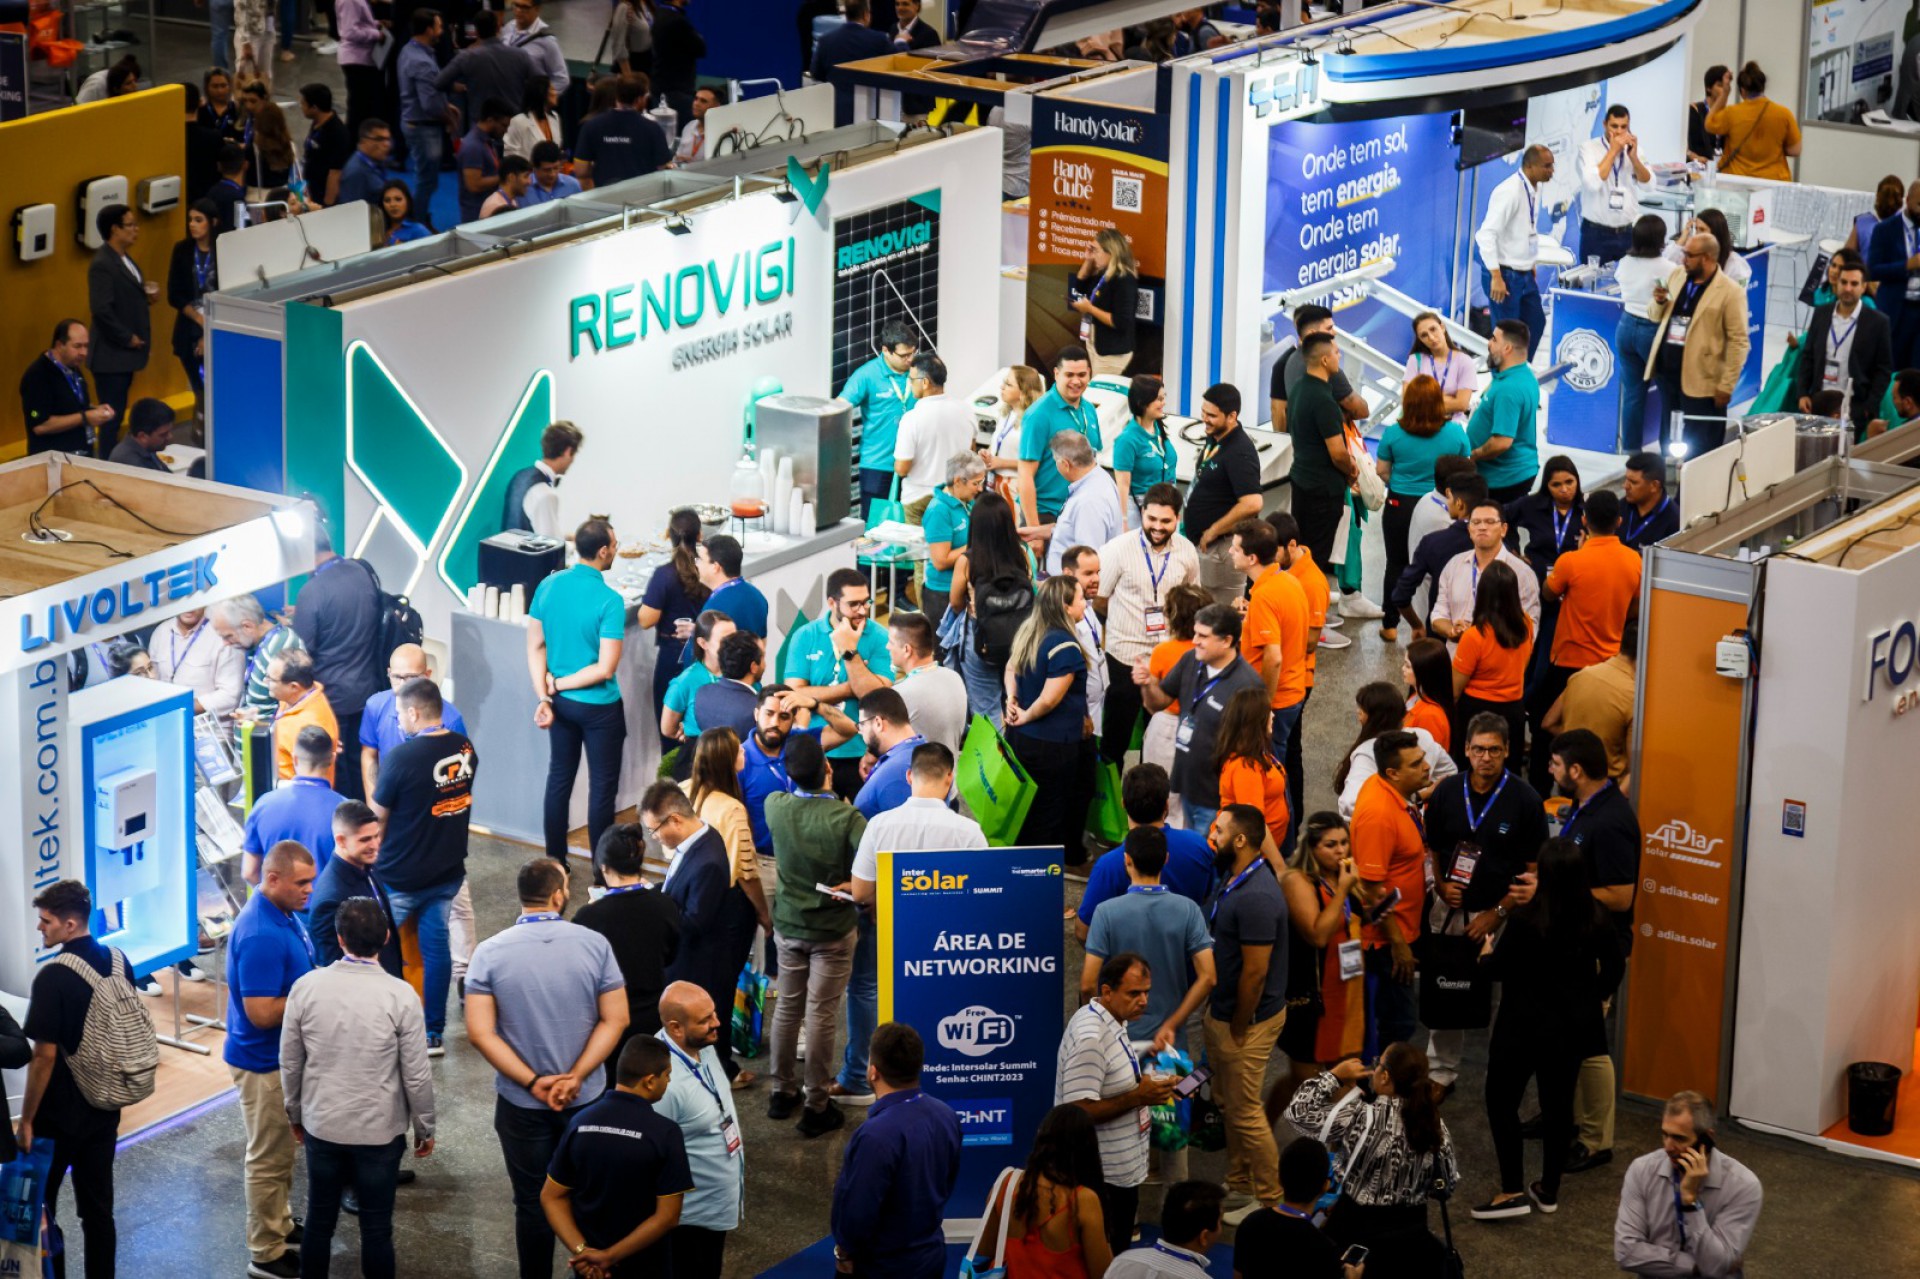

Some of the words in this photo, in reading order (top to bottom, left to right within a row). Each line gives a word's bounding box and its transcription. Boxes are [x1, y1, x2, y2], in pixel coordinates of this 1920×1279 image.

[1302, 144, 1347, 180] Onde
[1350, 138, 1381, 165] tem
[1384, 123, 1409, 155] sol,
[1053, 158, 1095, 184] Handy
[1301, 186, 1333, 216] tem
[1336, 161, 1402, 201] energia.
[1051, 210, 1081, 224] Prêmios
[1082, 215, 1099, 226] todo
[1099, 219, 1116, 229] mês
[1300, 214, 1344, 250] Onde
[1347, 207, 1379, 235] tem
[838, 219, 931, 270] RENOVIGI
[1051, 244, 1071, 256] Troca
[1298, 244, 1358, 285] energia
[1360, 232, 1402, 264] solar,
[570, 236, 794, 359] RENOVIGI
[671, 328, 740, 372] ENERGIA
[742, 311, 793, 350] SOLAR
[21, 551, 218, 651] LIVOLTEK
[1864, 618, 1920, 702] FO
[1894, 688, 1920, 717] en
[1645, 847, 1668, 858] solar
[901, 870, 969, 891] solar
[1659, 884, 1720, 905] adias.solar
[933, 930, 993, 952] ÁREA
[998, 932, 1026, 949] DE
[1657, 930, 1718, 950] adias.solar
[904, 956, 1056, 977] NETWORKING
[923, 1064, 950, 1072] Rede:
[951, 1063, 998, 1071] Intersolar
[1000, 1061, 1037, 1070] Summit
[936, 1075, 969, 1083] Senha:
[970, 1073, 1024, 1082] CHINT2023
